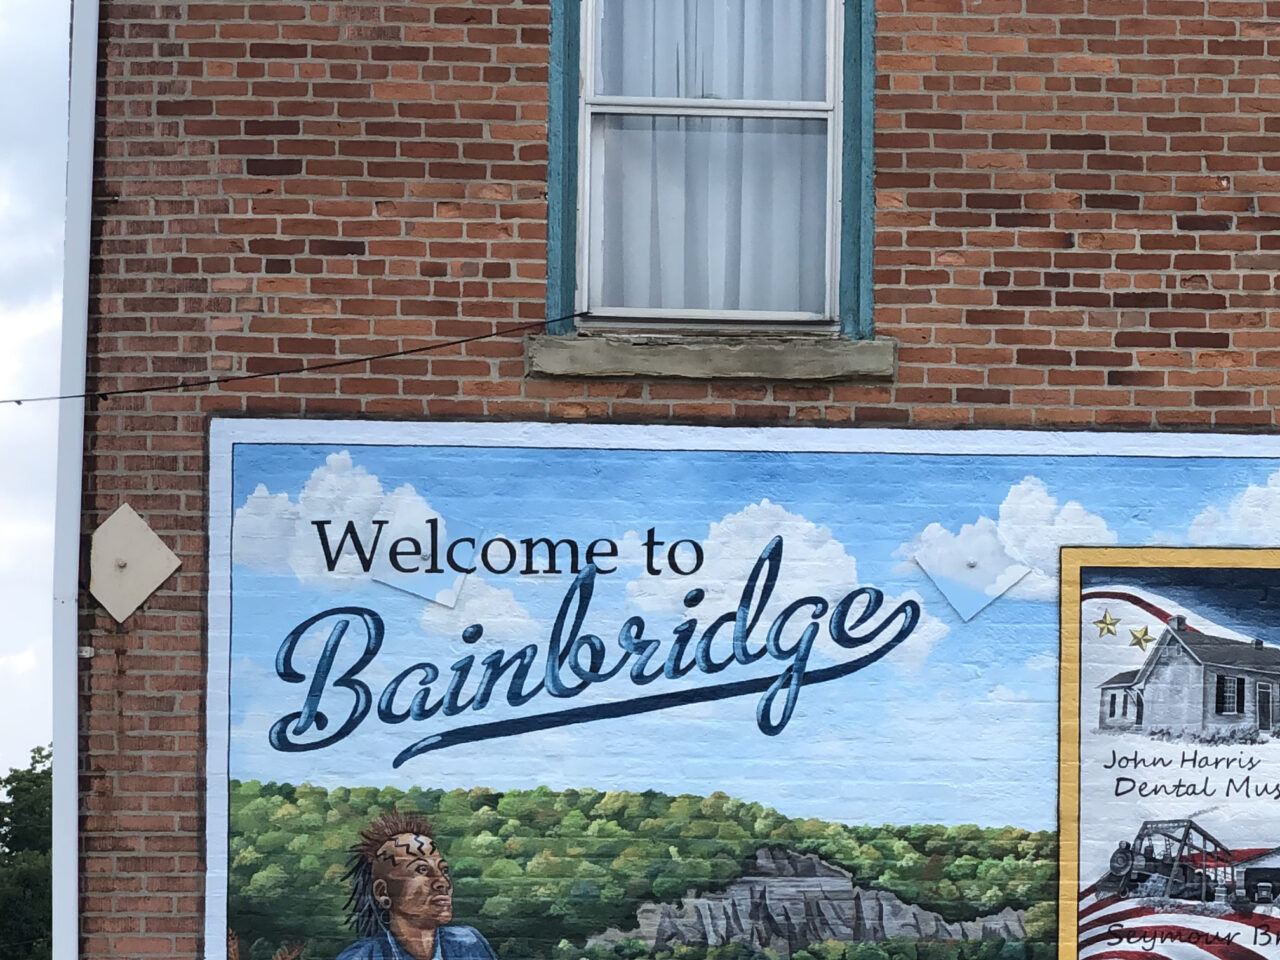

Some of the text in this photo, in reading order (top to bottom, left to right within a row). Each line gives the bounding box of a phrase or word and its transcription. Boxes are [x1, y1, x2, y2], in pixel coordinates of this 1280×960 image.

[311, 518, 704, 576] Welcome to
[268, 535, 922, 755] Bainbridge
[1103, 749, 1262, 771] John Harris
[1114, 776, 1217, 798] Dental
[1106, 923, 1241, 951] Seymour
